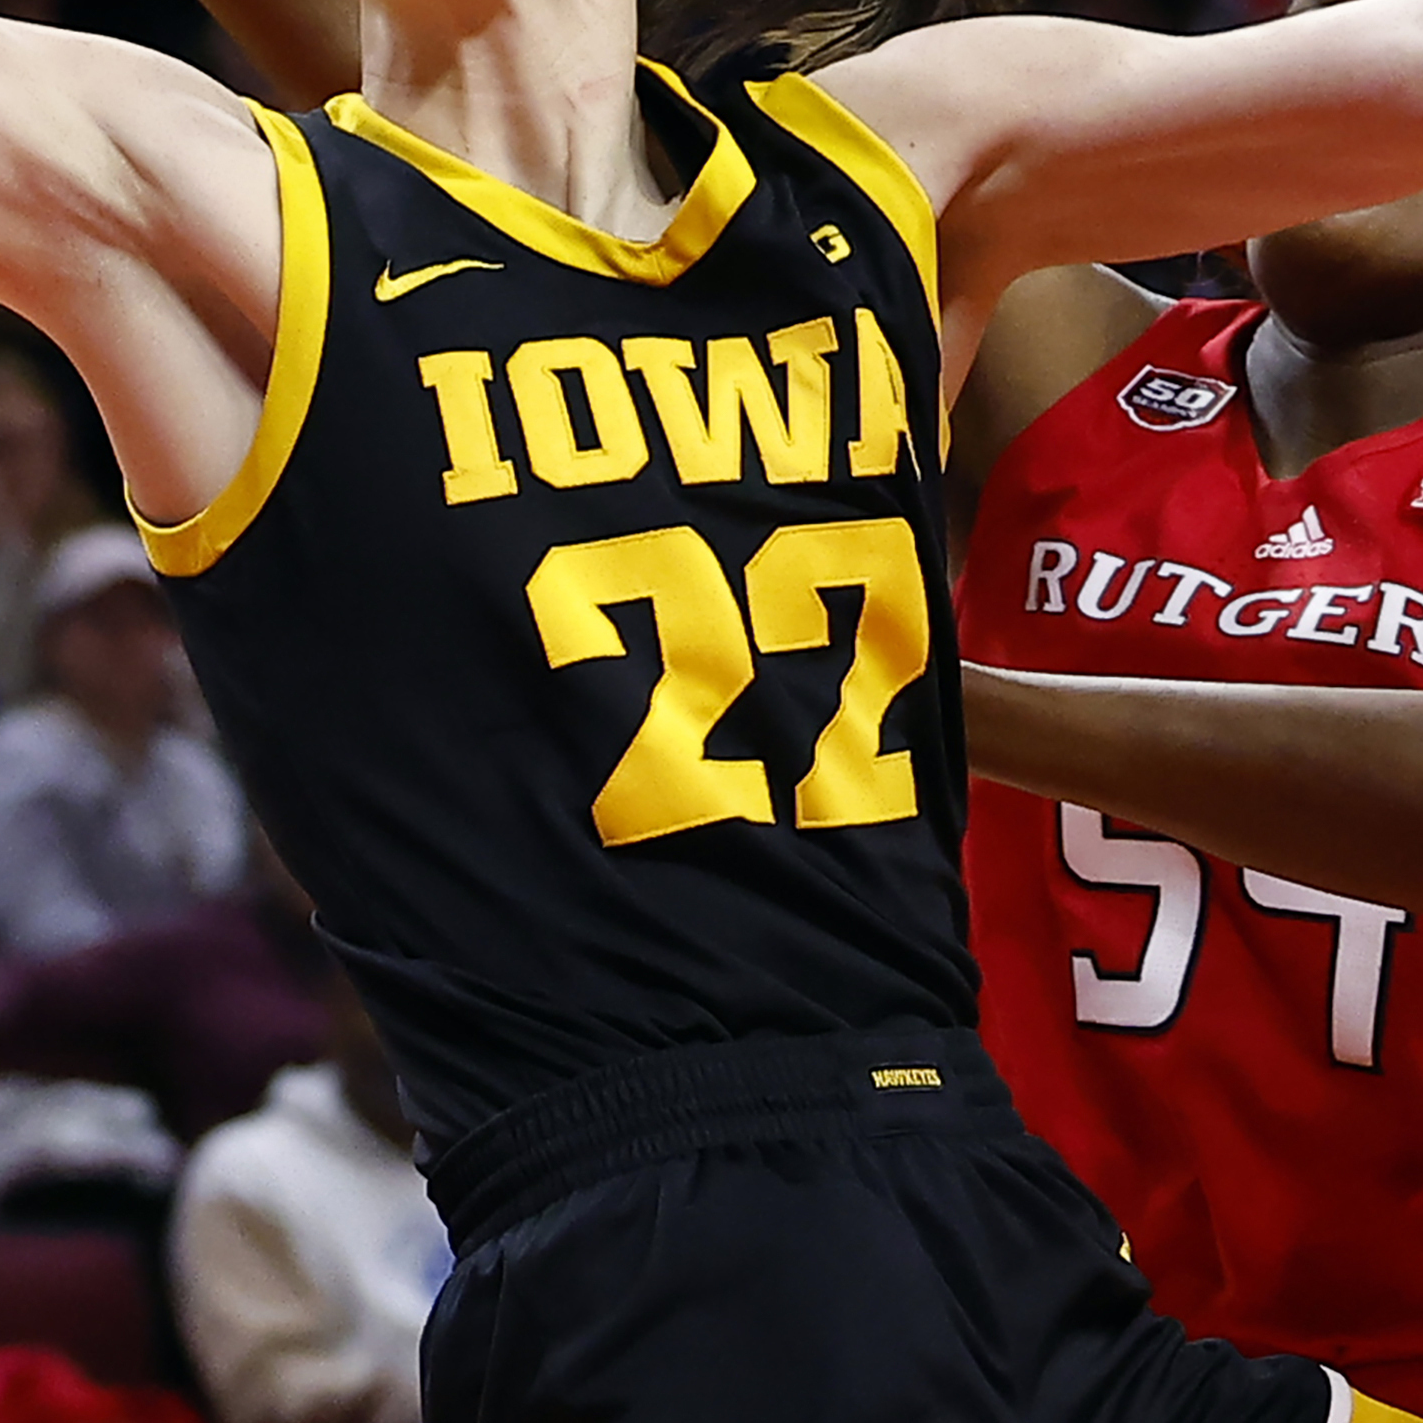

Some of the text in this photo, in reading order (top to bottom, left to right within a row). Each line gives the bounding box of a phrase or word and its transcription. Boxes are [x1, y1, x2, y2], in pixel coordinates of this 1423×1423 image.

[418, 307, 921, 505] IOWA
[1139, 378, 1216, 410] 50
[1255, 538, 1333, 559] adidas
[526, 517, 929, 848] 22
